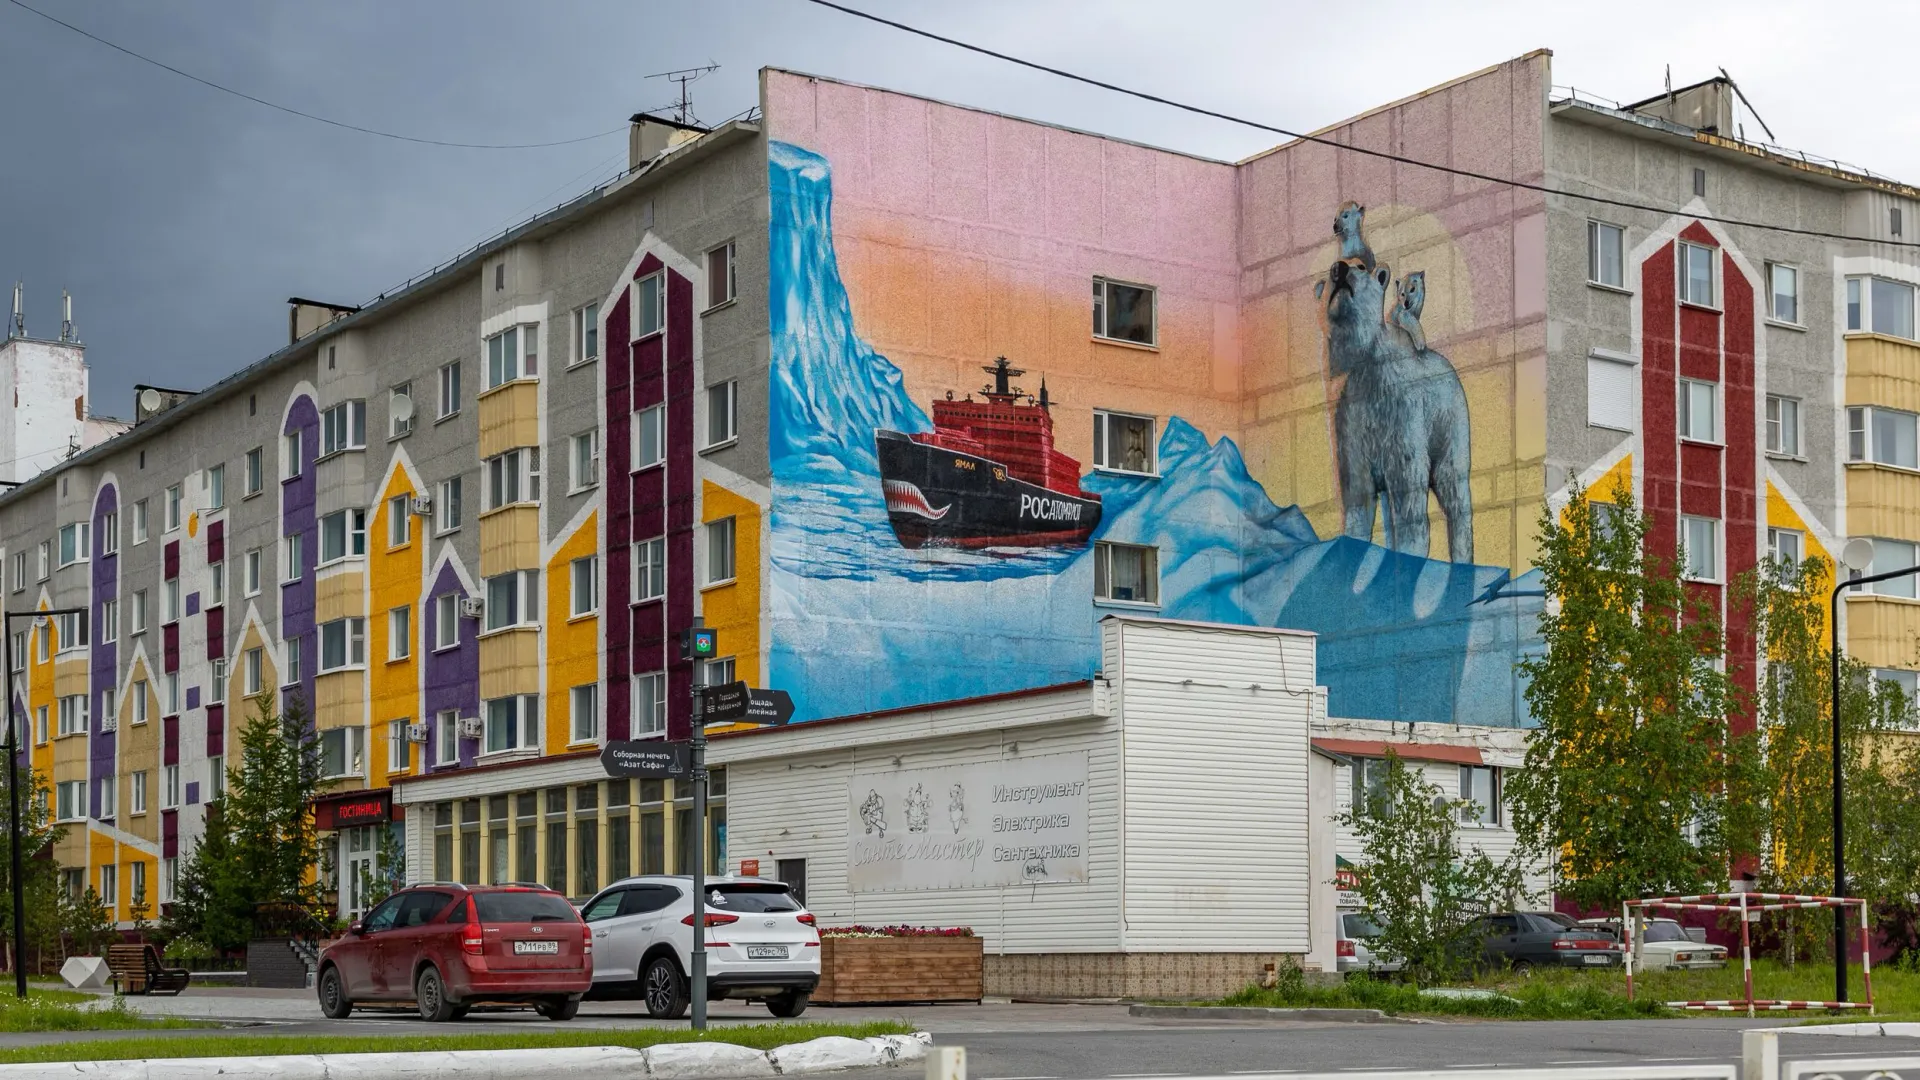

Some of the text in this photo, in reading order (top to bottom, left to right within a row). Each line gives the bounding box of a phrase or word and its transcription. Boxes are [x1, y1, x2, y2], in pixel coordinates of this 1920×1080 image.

[954, 458, 976, 471] ЯМАЛ
[1020, 493, 1082, 521] РОСАТОМФЛОТ
[718, 691, 740, 701] Городская
[750, 699, 773, 707] ощадь
[747, 708, 777, 716] илейная
[612, 750, 671, 760] Соборная мечеть
[618, 760, 665, 770] «Азат Сафа»
[991, 780, 1084, 804] Инструмент
[339, 801, 382, 819] ГОСТИНИЦА
[991, 812, 1070, 834] Электрика
[991, 843, 1081, 864] Сантехника
